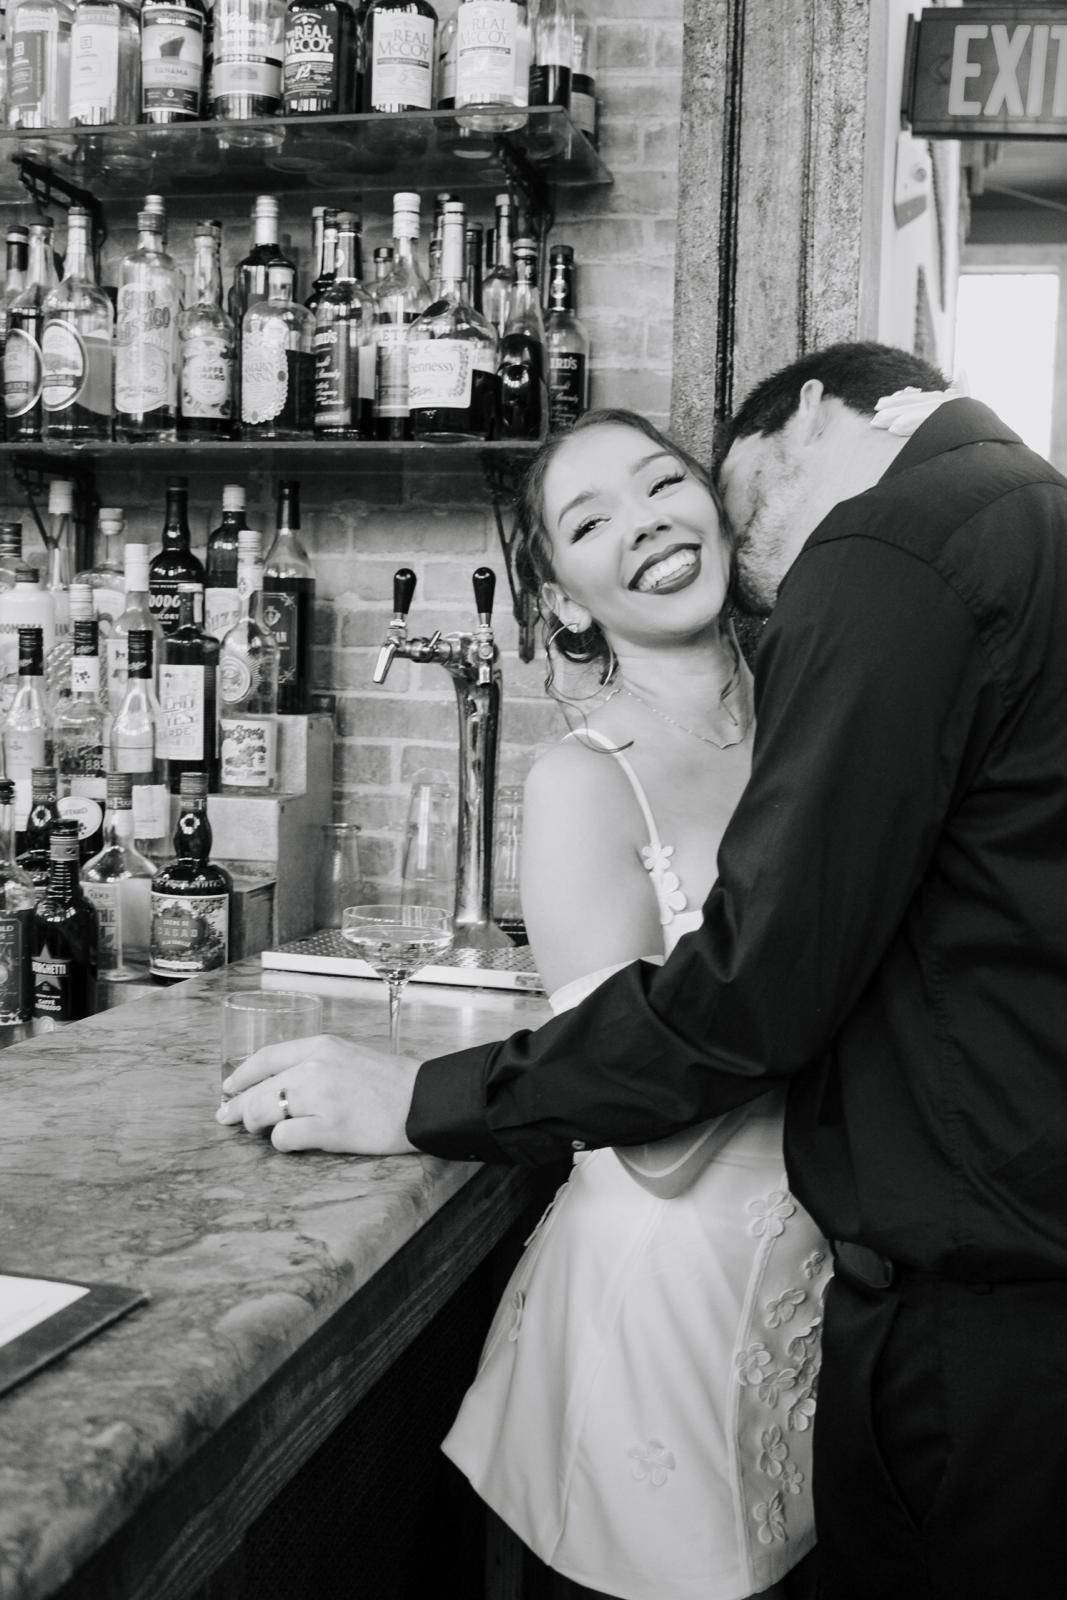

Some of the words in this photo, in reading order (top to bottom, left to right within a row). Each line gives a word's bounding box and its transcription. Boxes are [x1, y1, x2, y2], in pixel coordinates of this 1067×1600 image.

[294, 24, 331, 39] REAL
[473, 17, 508, 31] REAL
[394, 29, 429, 46] REAL
[948, 24, 1067, 117] EXIT
